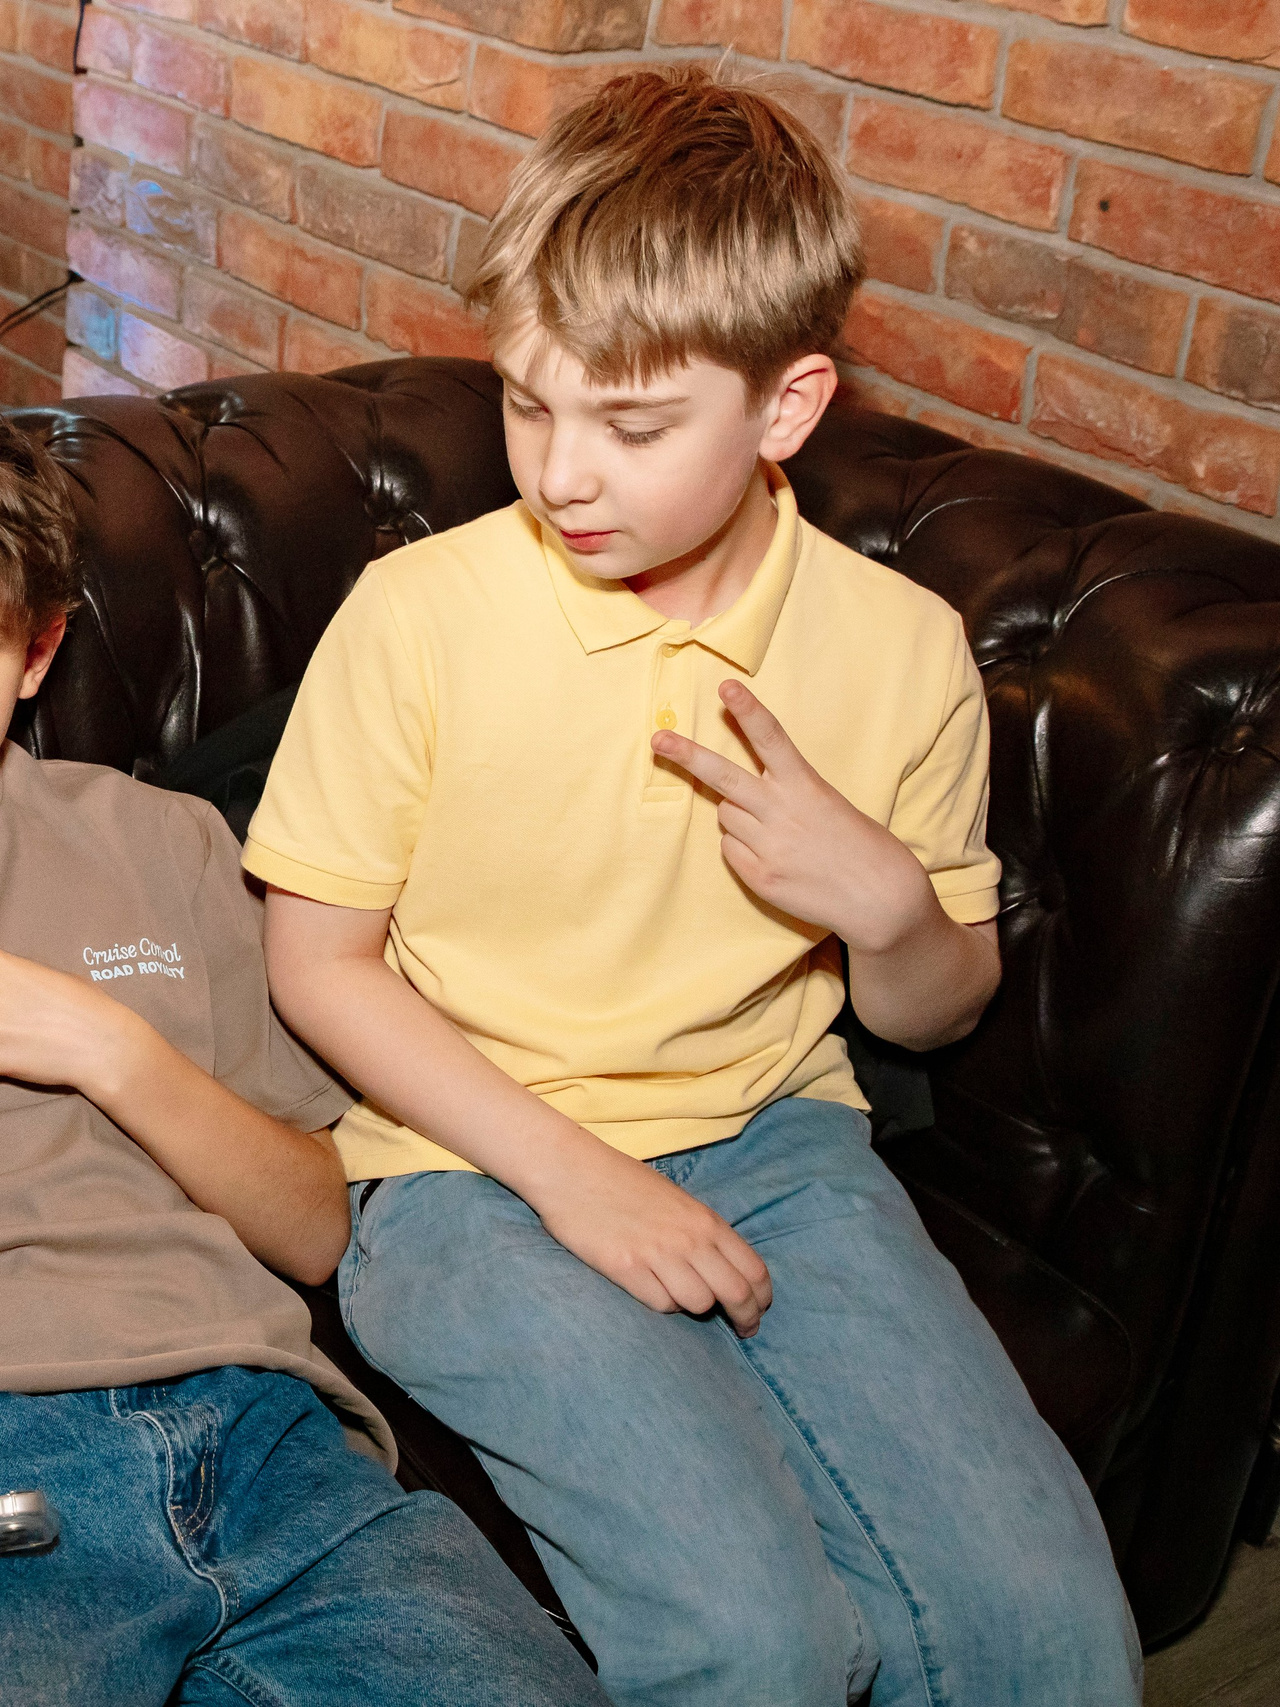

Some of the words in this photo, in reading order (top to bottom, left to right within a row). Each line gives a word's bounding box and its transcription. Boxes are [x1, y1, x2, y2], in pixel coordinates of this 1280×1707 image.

[83, 943, 138, 965] Cruise
[139, 937, 181, 963] Conol
[90, 964, 134, 981] ROAD
